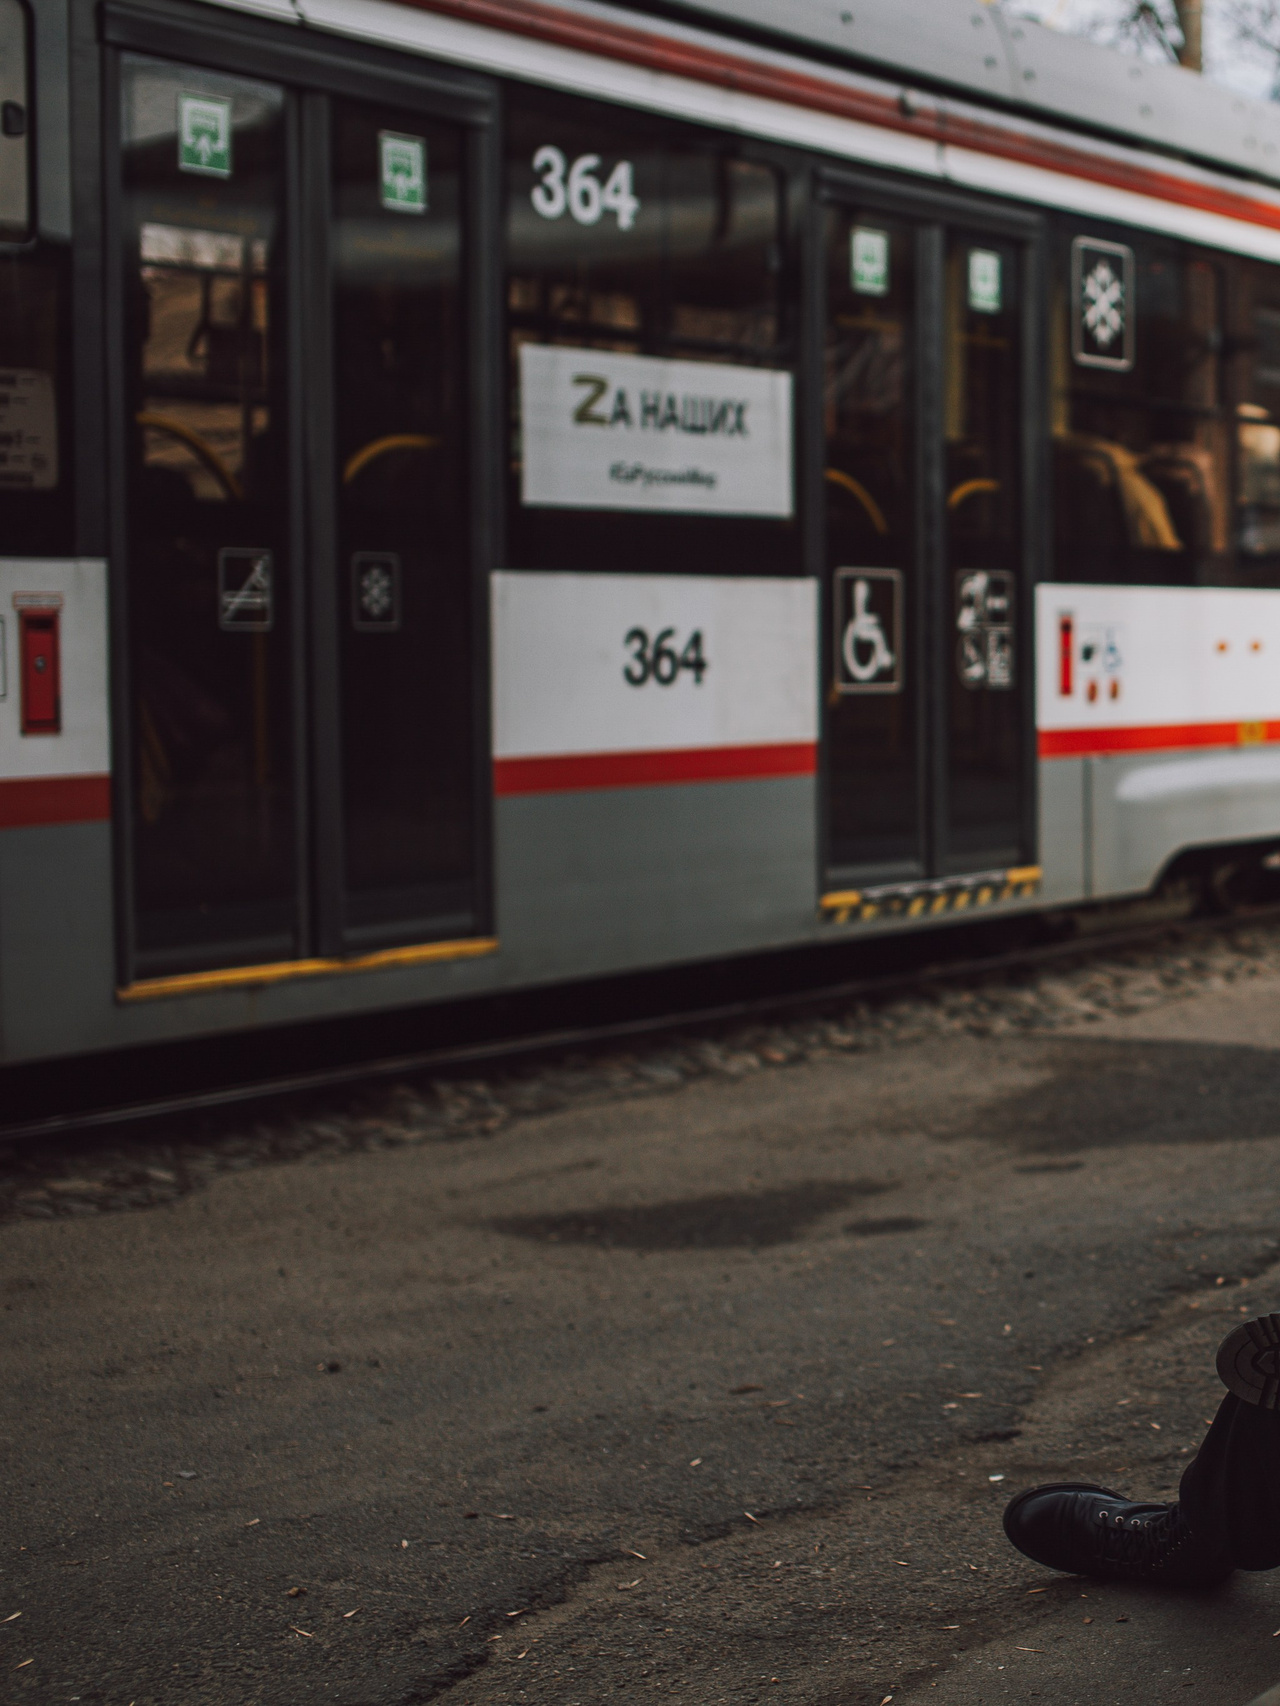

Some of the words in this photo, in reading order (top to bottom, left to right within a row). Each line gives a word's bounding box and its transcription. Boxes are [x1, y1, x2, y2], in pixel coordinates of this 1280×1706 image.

[531, 145, 640, 230] 364
[640, 391, 748, 435] НАШИХ
[623, 626, 707, 686] 364
